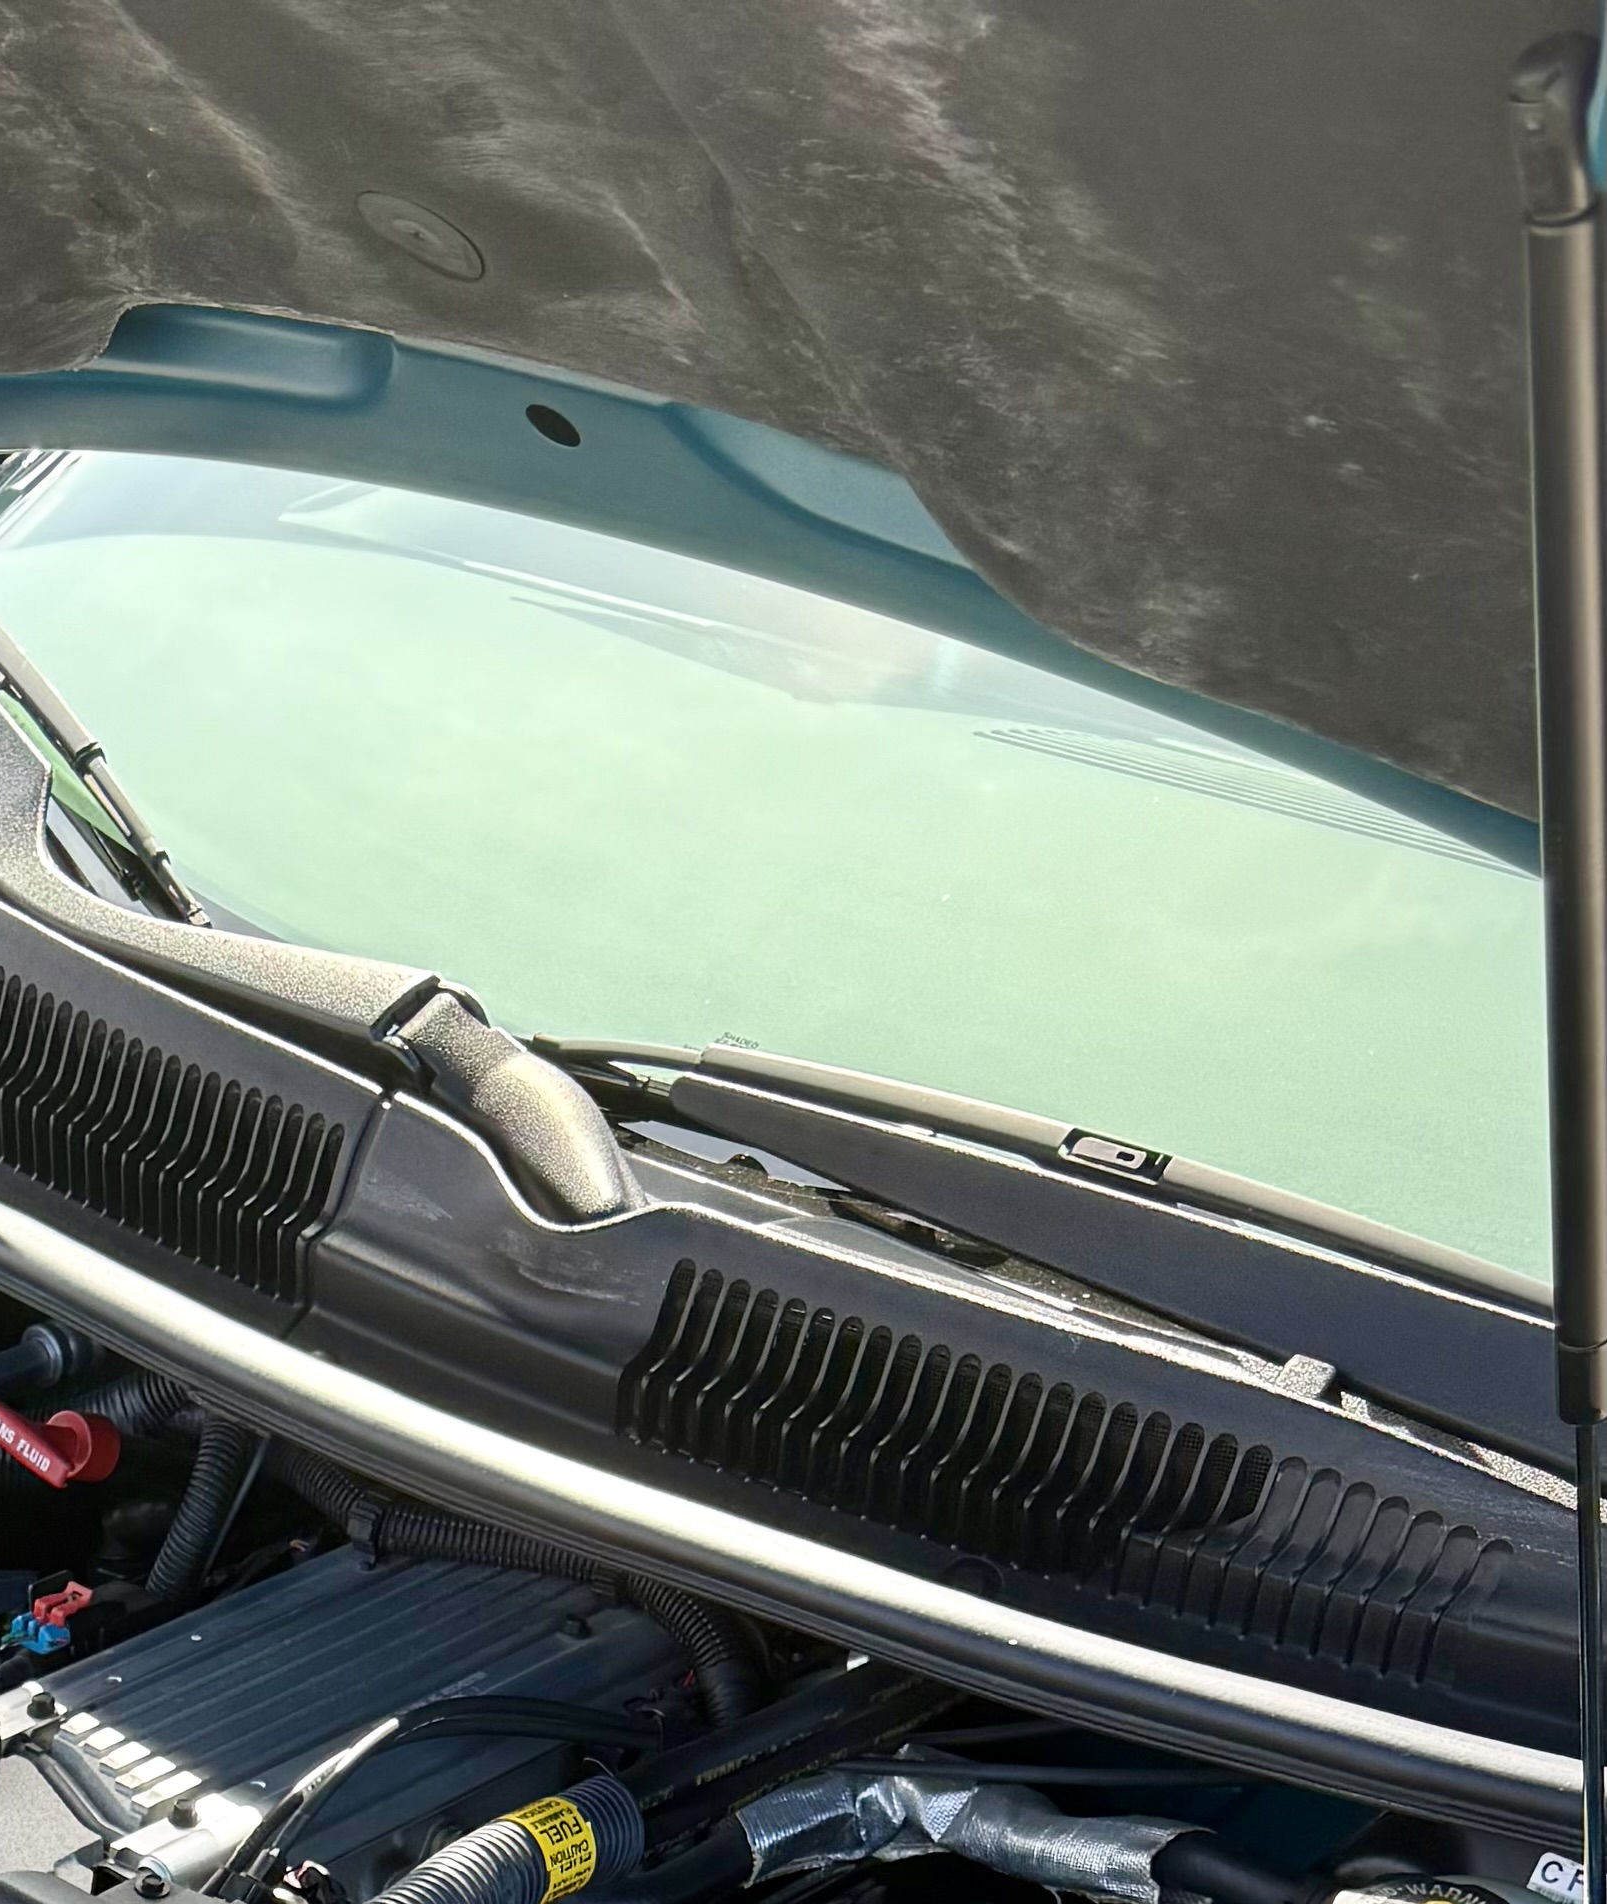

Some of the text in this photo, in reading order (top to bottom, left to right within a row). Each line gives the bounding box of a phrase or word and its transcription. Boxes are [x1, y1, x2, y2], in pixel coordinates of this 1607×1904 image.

[14, 1437, 53, 1473] FLUID
[539, 1815, 582, 1846] FUEL
[549, 1839, 589, 1868] CAUTION
